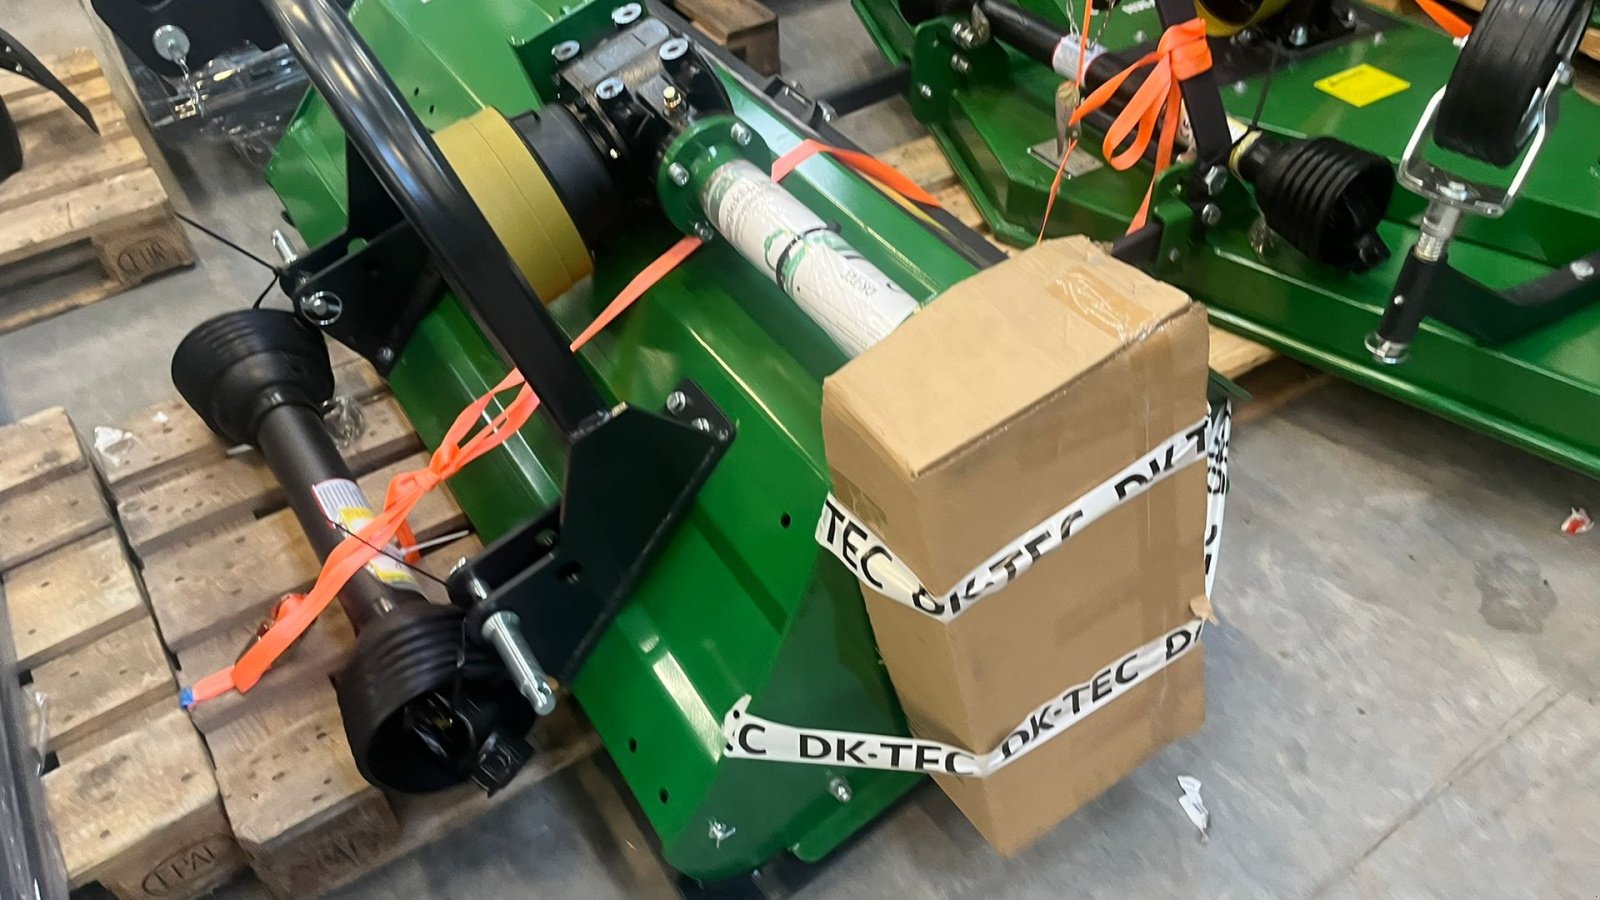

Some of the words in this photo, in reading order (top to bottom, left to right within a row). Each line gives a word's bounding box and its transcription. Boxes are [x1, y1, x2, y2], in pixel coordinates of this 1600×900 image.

[825, 499, 893, 590] TEC
[799, 733, 976, 776] DK-TEC
[1001, 653, 1139, 761] DK-TEC
[1166, 622, 1203, 662] D
